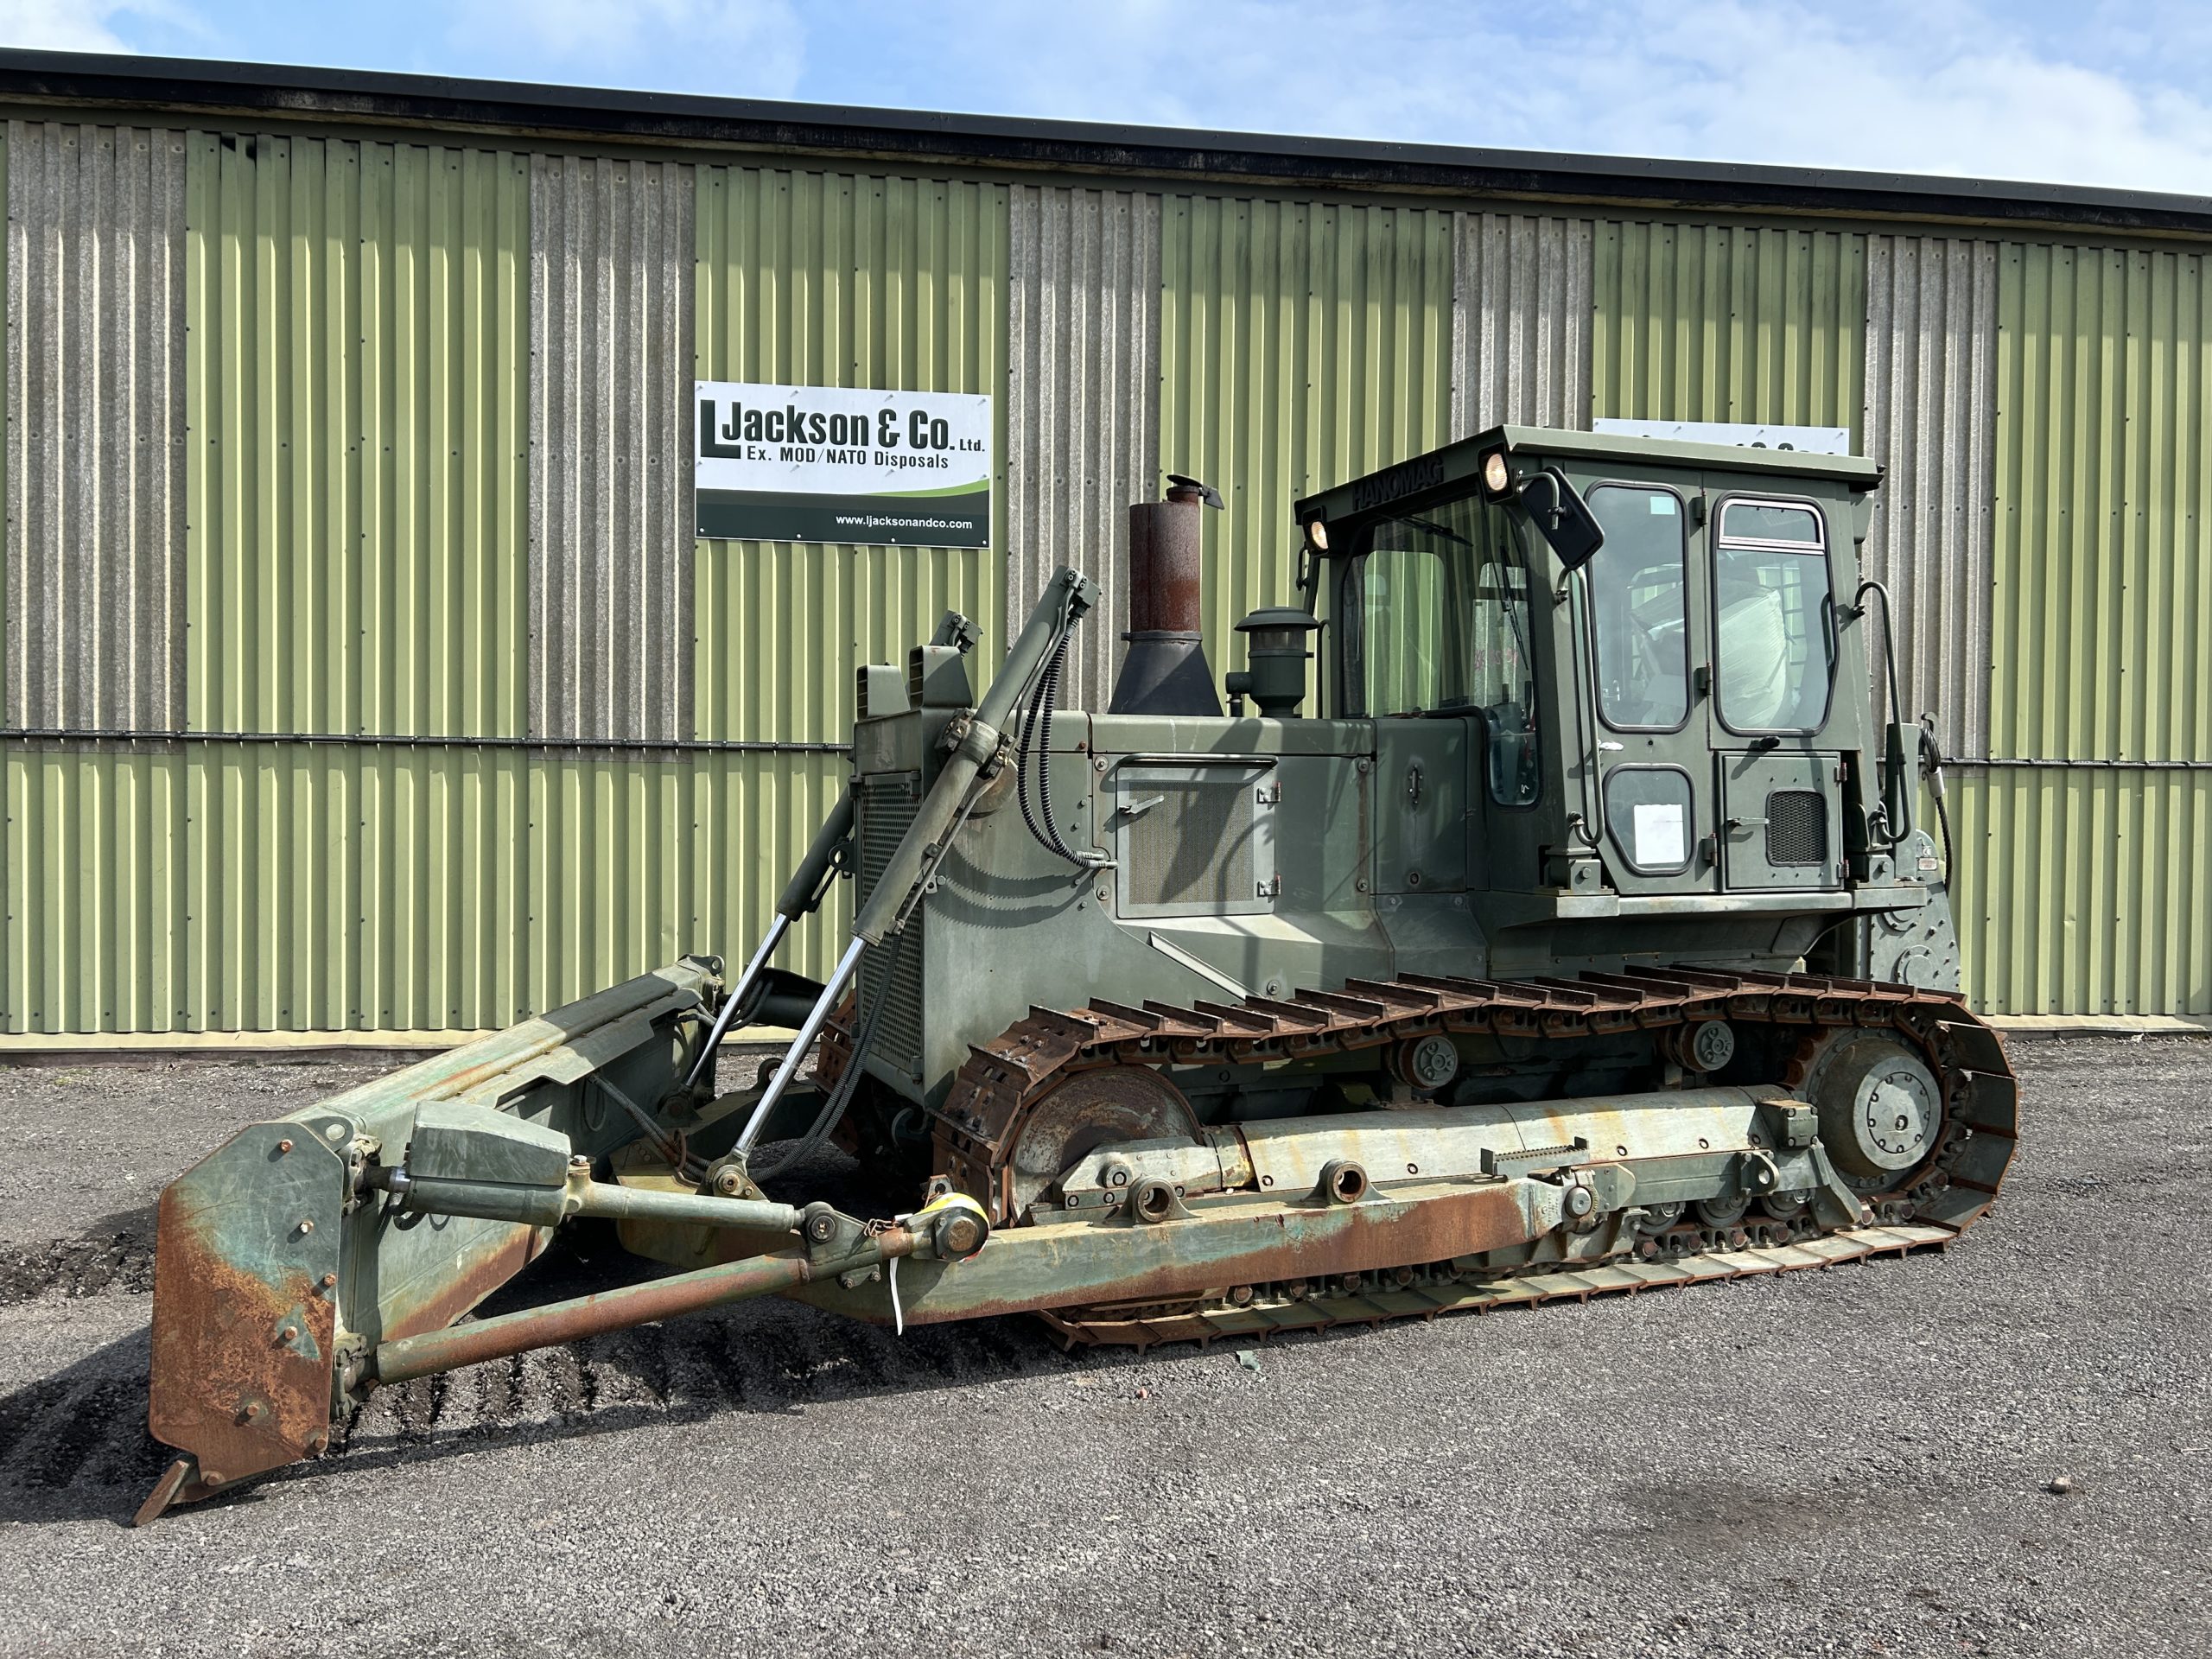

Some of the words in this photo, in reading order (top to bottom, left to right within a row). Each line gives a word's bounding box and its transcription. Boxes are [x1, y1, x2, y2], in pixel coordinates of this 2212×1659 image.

[878, 409, 900, 448] &
[909, 410, 956, 451] Co.
[959, 438, 986, 452] Ltd.
[747, 445, 772, 461] Ex.
[780, 447, 867, 466] MOD/NATO
[874, 451, 949, 469] Disposals
[1352, 455, 1445, 512] HANOMAG
[836, 514, 973, 530] www.ljacksonandco.com
